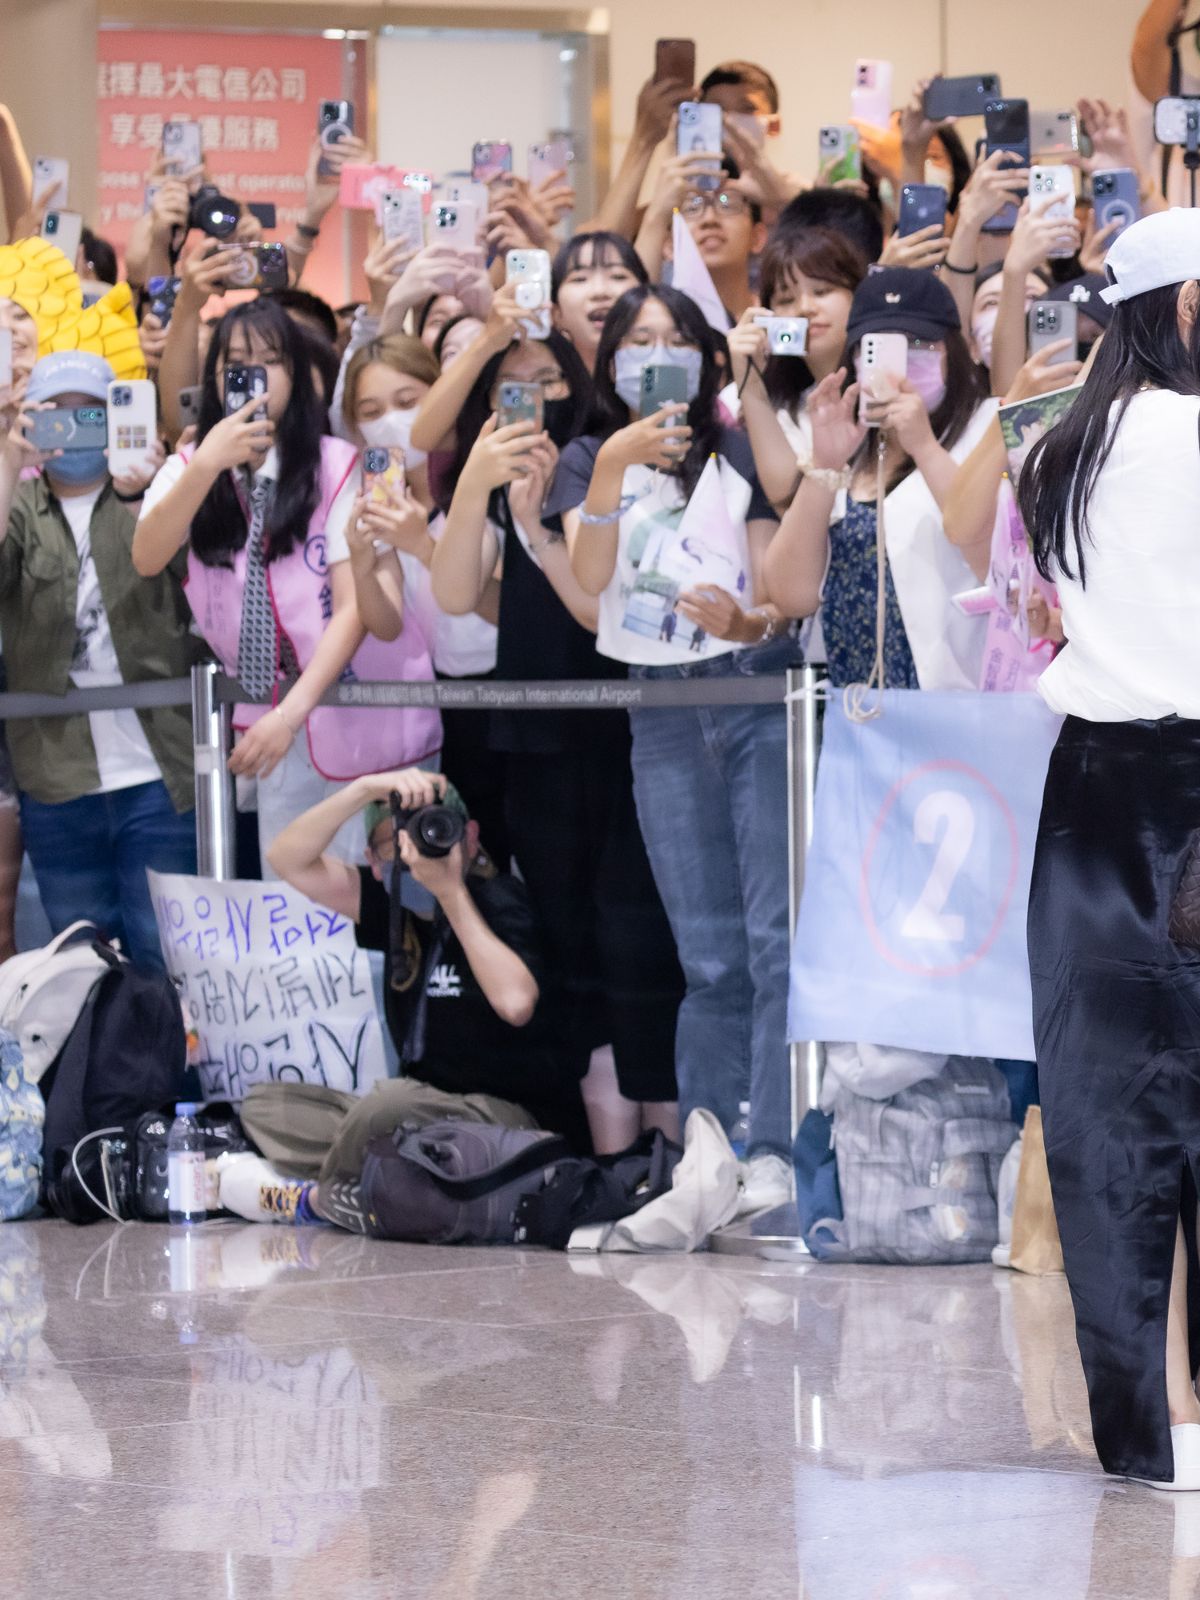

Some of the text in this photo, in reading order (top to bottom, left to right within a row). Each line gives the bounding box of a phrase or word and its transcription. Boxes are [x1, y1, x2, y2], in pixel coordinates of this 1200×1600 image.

[436, 684, 474, 702] Taiwan
[477, 685, 525, 705] Taoyuan
[526, 685, 599, 702] International
[601, 685, 643, 705] Airport
[901, 789, 976, 942] 2
